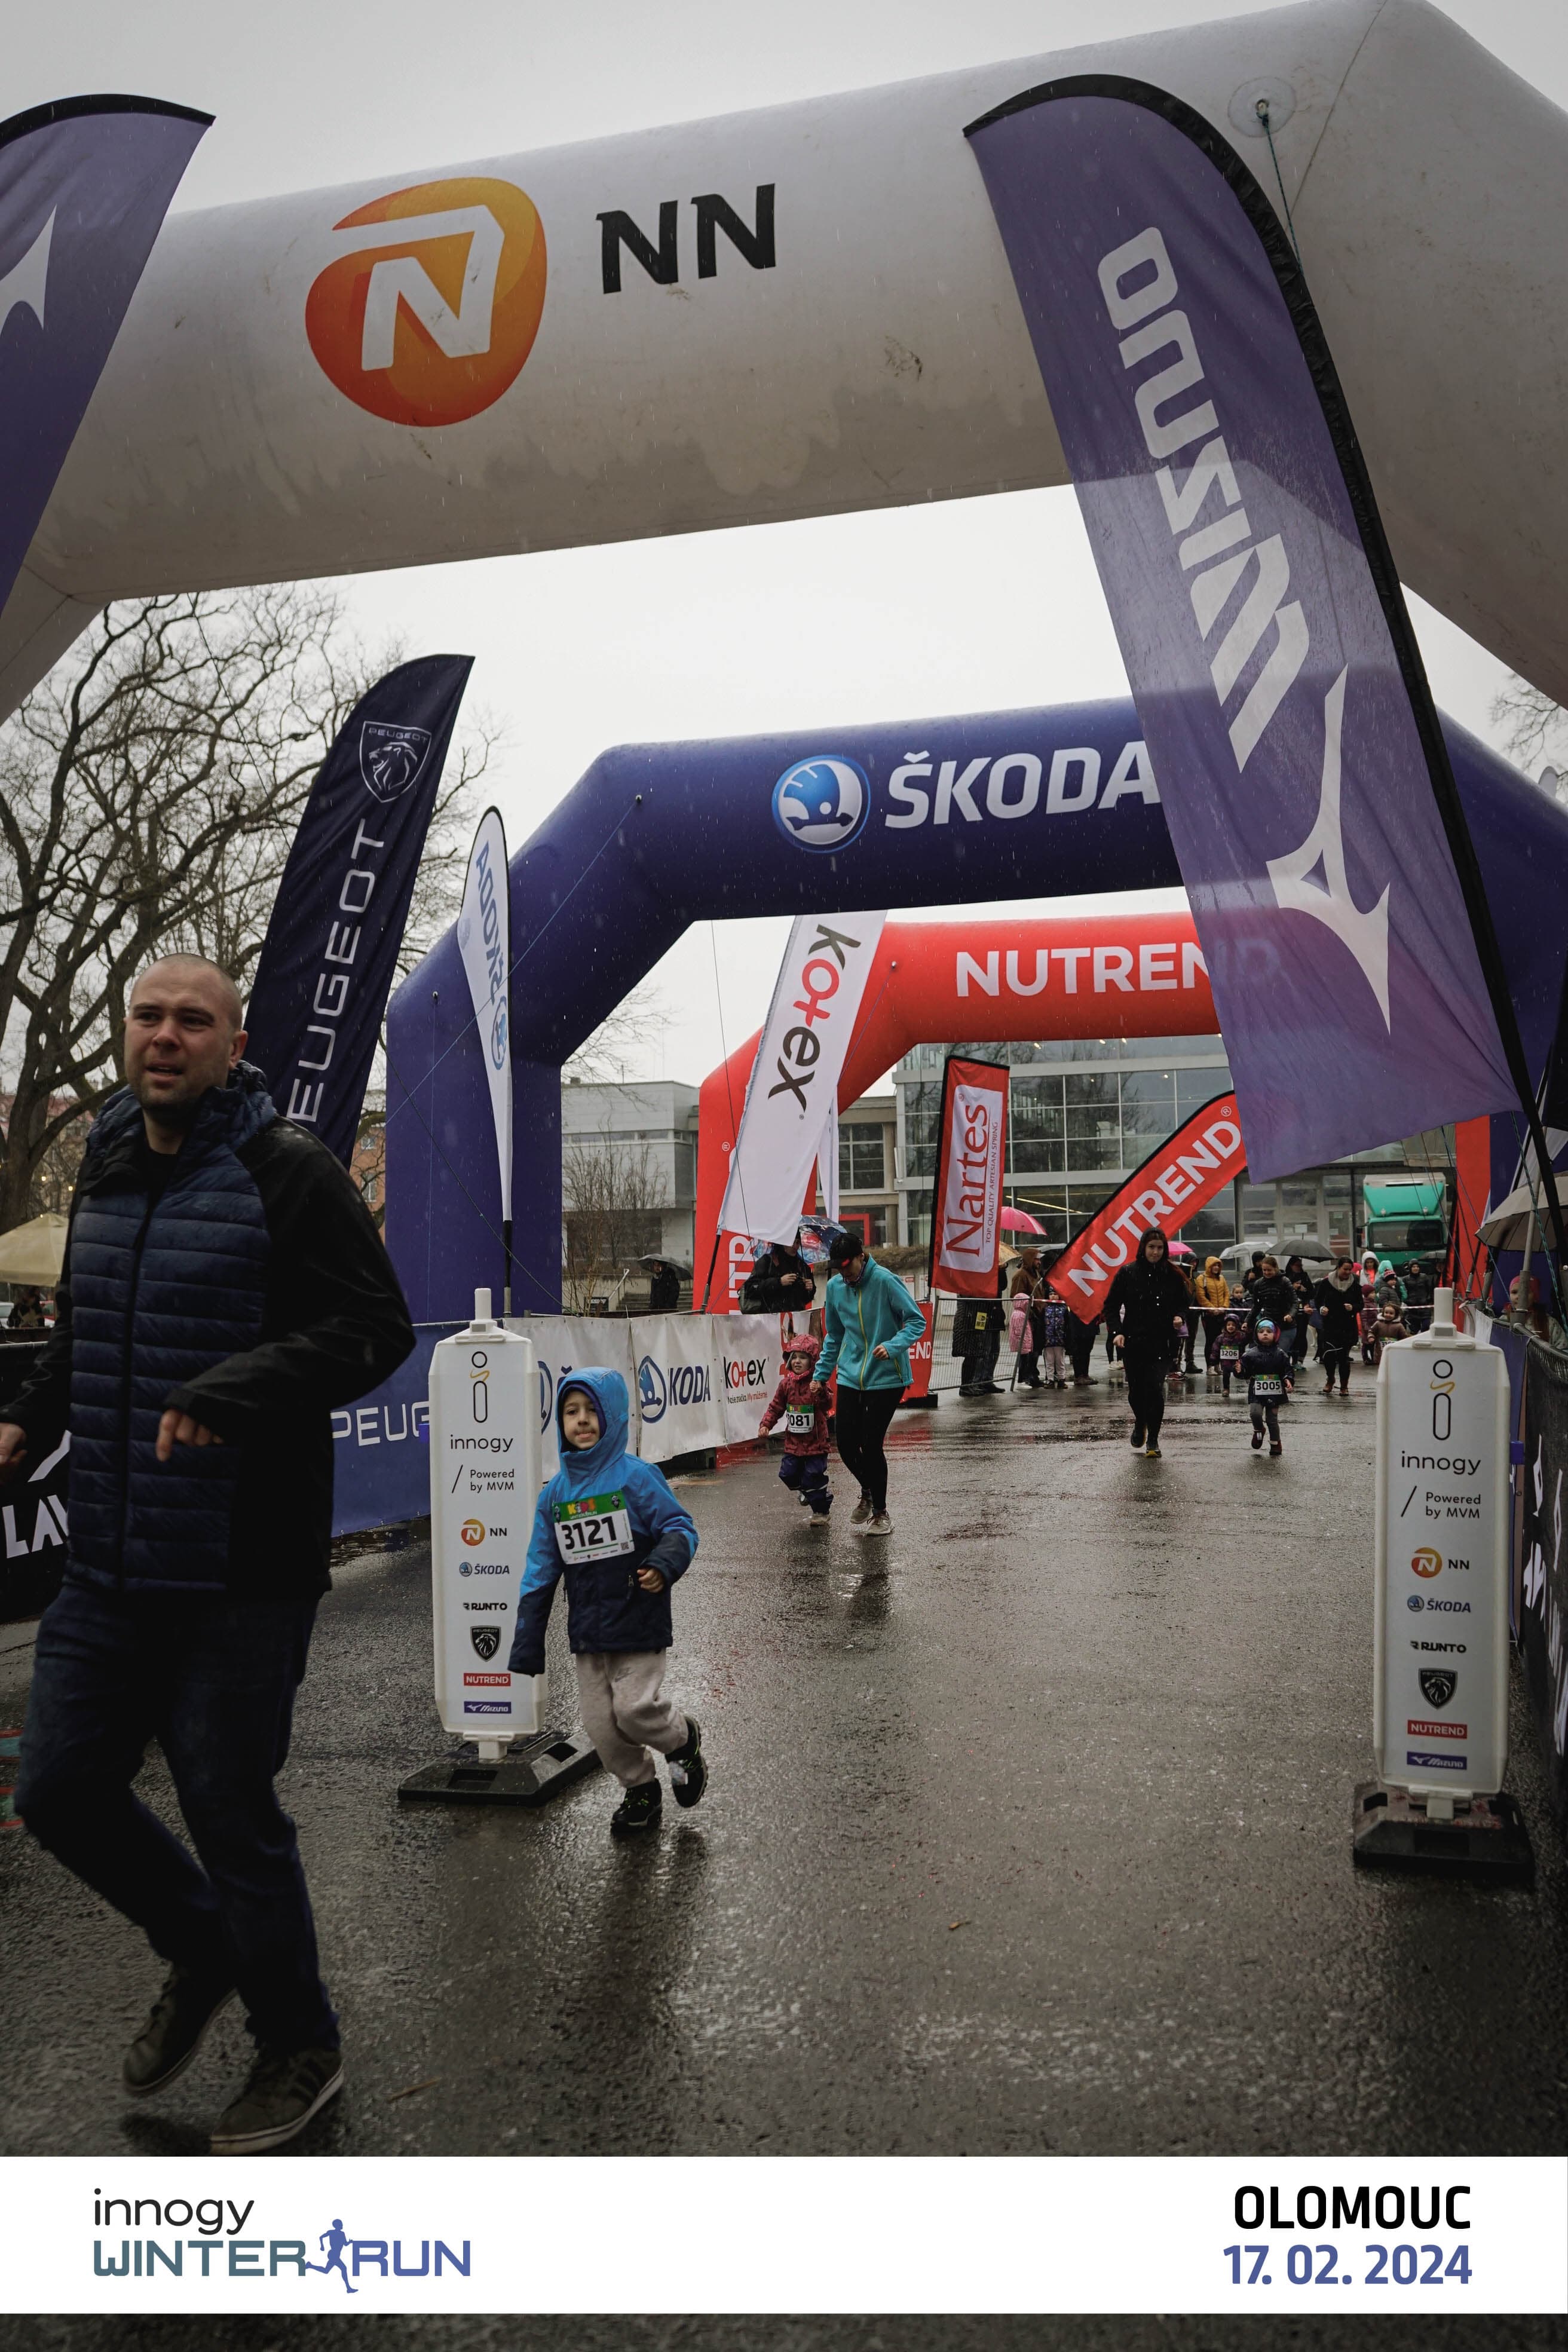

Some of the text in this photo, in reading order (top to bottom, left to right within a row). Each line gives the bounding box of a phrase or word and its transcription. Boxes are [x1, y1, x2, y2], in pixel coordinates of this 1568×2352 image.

[596, 183, 776, 295] NN
[368, 727, 428, 744] PEUGEOT
[884, 740, 1162, 829] ŠKODA
[286, 818, 385, 1123] EUGEOT
[945, 1104, 988, 1257] Nartes
[1067, 1121, 1241, 1297] NUTREND
[724, 1356, 767, 1389] kotex
[668, 1365, 711, 1405] KODA
[1256, 1382, 1280, 1391] 3005
[330, 1401, 429, 1446] PEUG
[450, 1435, 513, 1452] innogy
[1401, 1451, 1481, 1475] innogy
[470, 1469, 514, 1478] Powered
[470, 1482, 514, 1493] by MVM
[1426, 1492, 1481, 1505] Powered
[1426, 1506, 1480, 1520] by MVM
[490, 1528, 507, 1536] NN
[561, 1516, 617, 1550] 3121
[474, 1563, 510, 1575] ŠKODA
[1448, 1559, 1469, 1570] NN
[1426, 1597, 1471, 1613] ŠKODA
[466, 1676, 509, 1684] NUTREND
[1411, 1723, 1465, 1737] NUTREND
